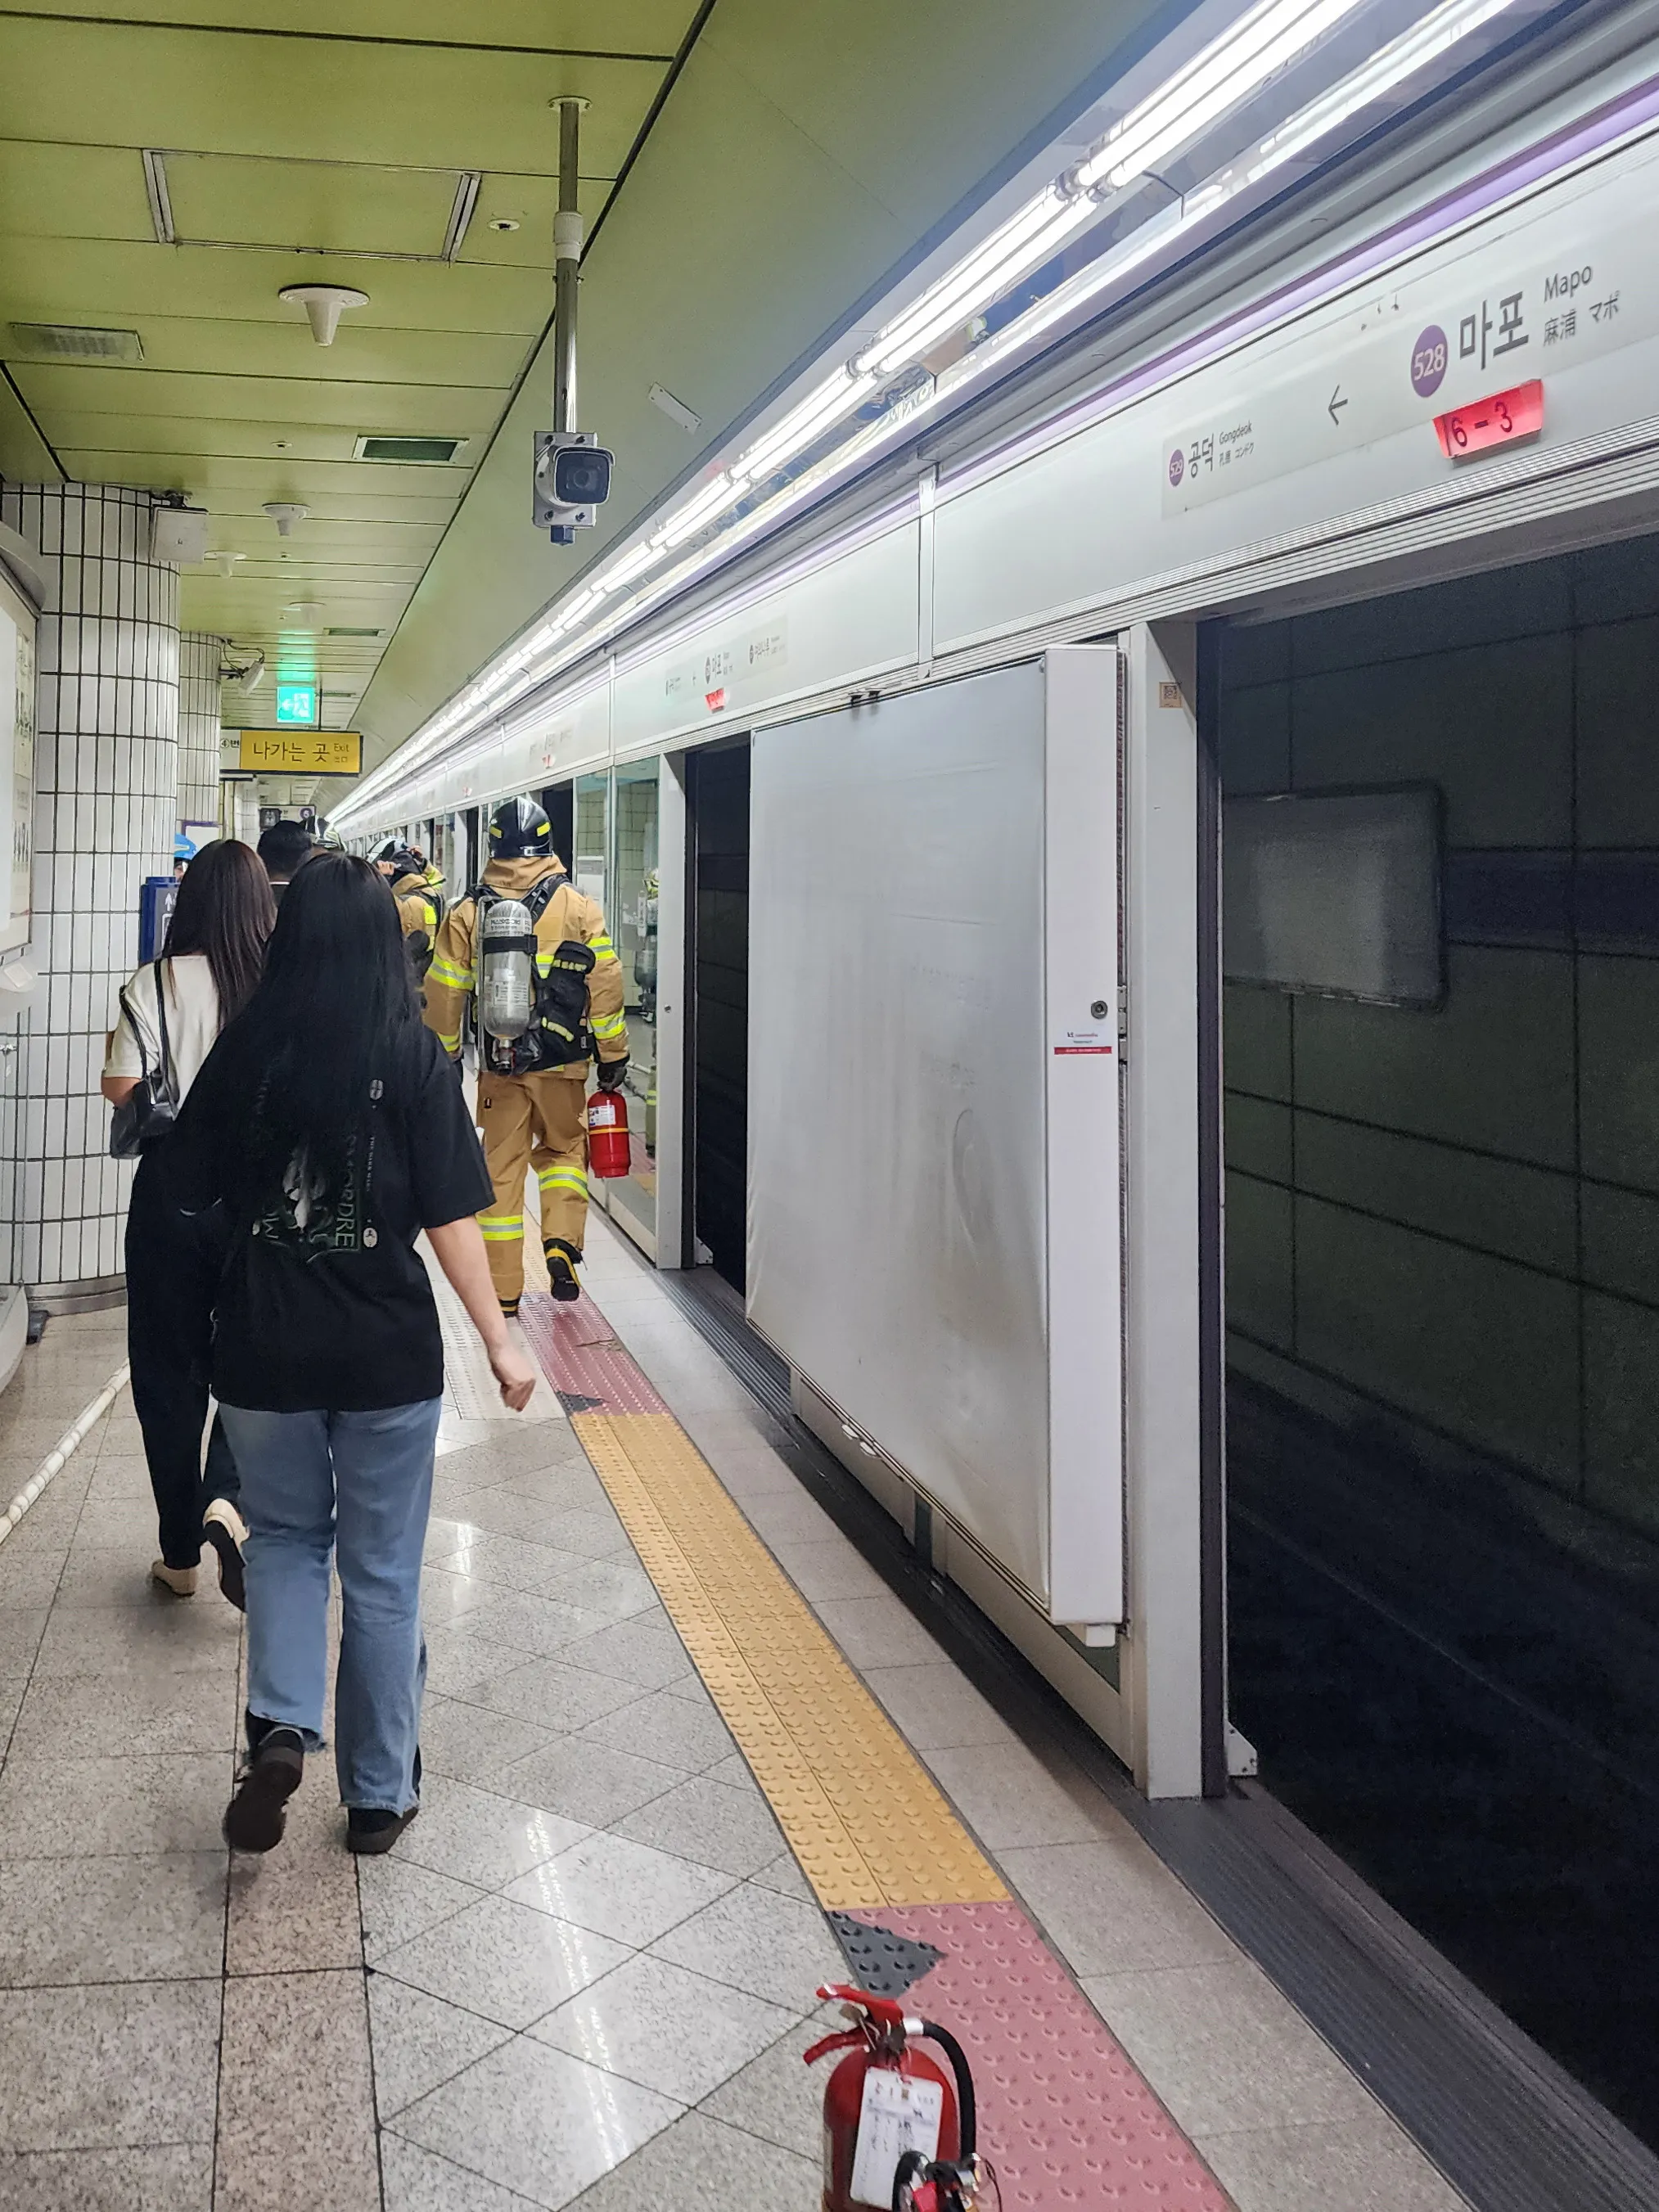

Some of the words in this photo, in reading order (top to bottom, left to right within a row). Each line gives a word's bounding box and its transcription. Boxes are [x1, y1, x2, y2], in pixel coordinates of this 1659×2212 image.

[1544, 266, 1592, 304] Mapo
[1413, 343, 1445, 381] 528
[1459, 291, 1529, 370] 마포
[1544, 308, 1576, 347] 麻浦
[1589, 290, 1620, 322] マポ
[1219, 419, 1251, 445] Gongdeok
[1170, 458, 1183, 478] 529
[1188, 433, 1214, 479] 공덕
[254, 741, 305, 762] 나가는
[313, 743, 330, 763] 곳
[334, 743, 349, 753] Exit
